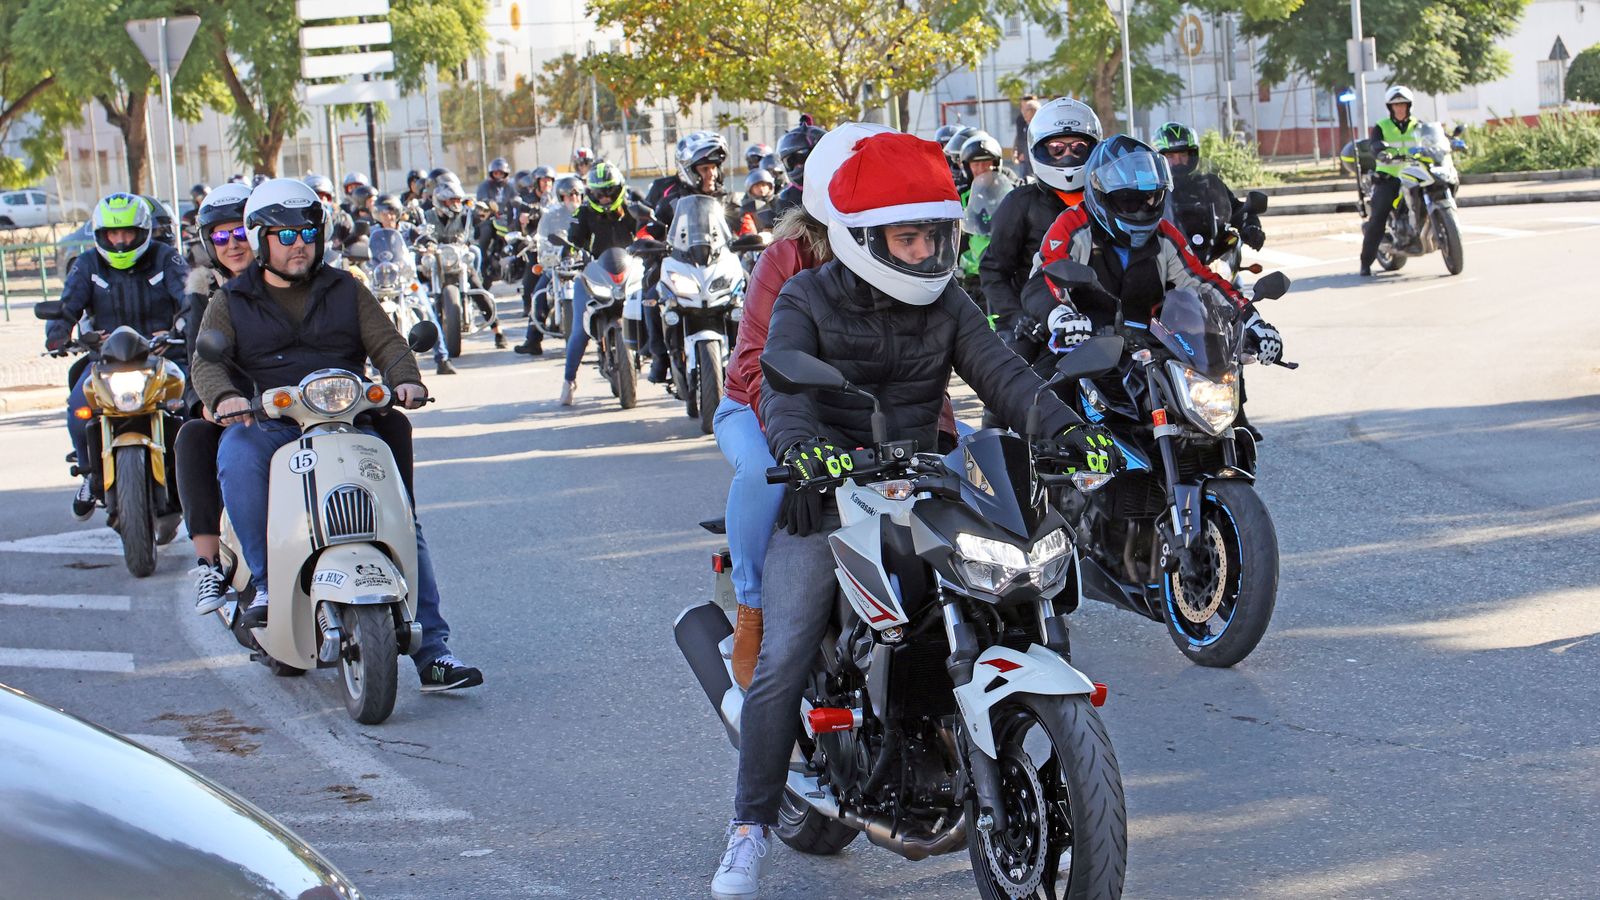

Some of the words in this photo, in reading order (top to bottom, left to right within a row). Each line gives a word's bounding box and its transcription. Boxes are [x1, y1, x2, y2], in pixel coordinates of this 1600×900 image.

[294, 453, 313, 470] 15
[850, 491, 878, 516] Kawasaki
[325, 572, 344, 585] HNZ
[431, 665, 445, 682] N
